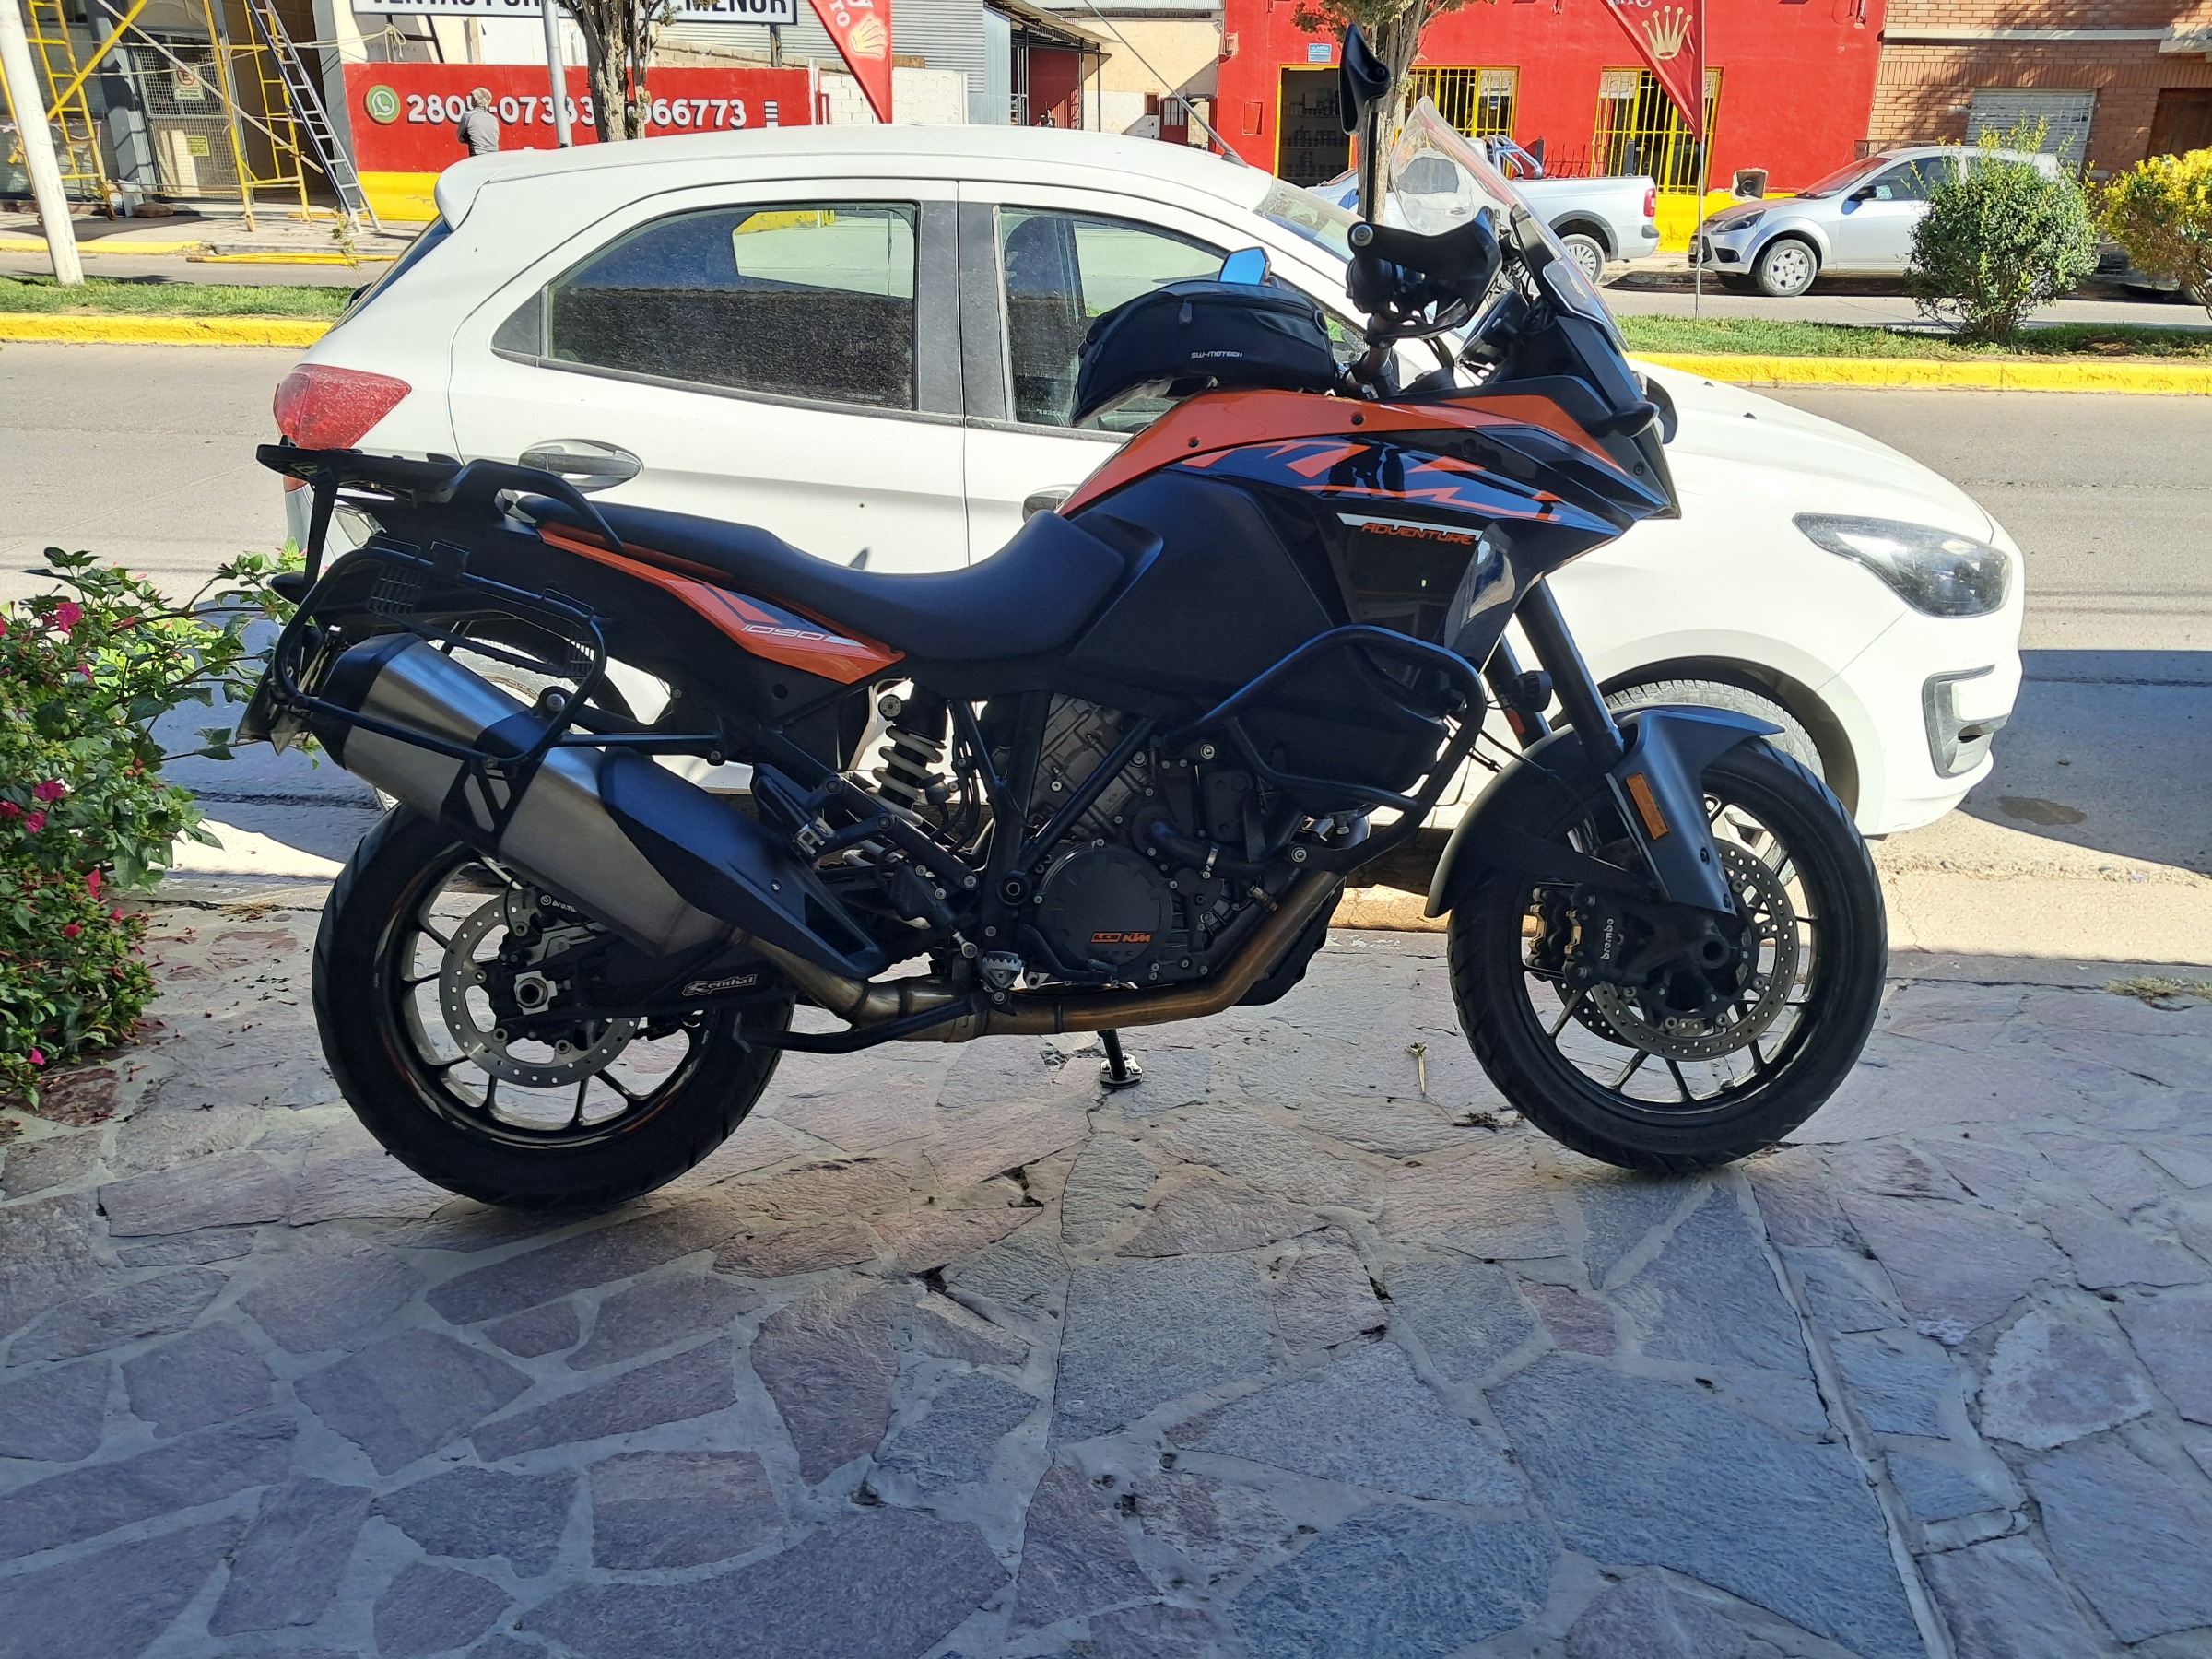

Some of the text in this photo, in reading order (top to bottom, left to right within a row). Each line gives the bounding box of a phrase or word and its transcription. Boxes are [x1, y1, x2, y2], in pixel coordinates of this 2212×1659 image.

[1361, 523, 1476, 546] ADVENTURE
[741, 624, 825, 641] 1090
[552, 900, 578, 913] brem
[1123, 933, 1151, 942] KTM
[1600, 918, 1614, 959] brembo
